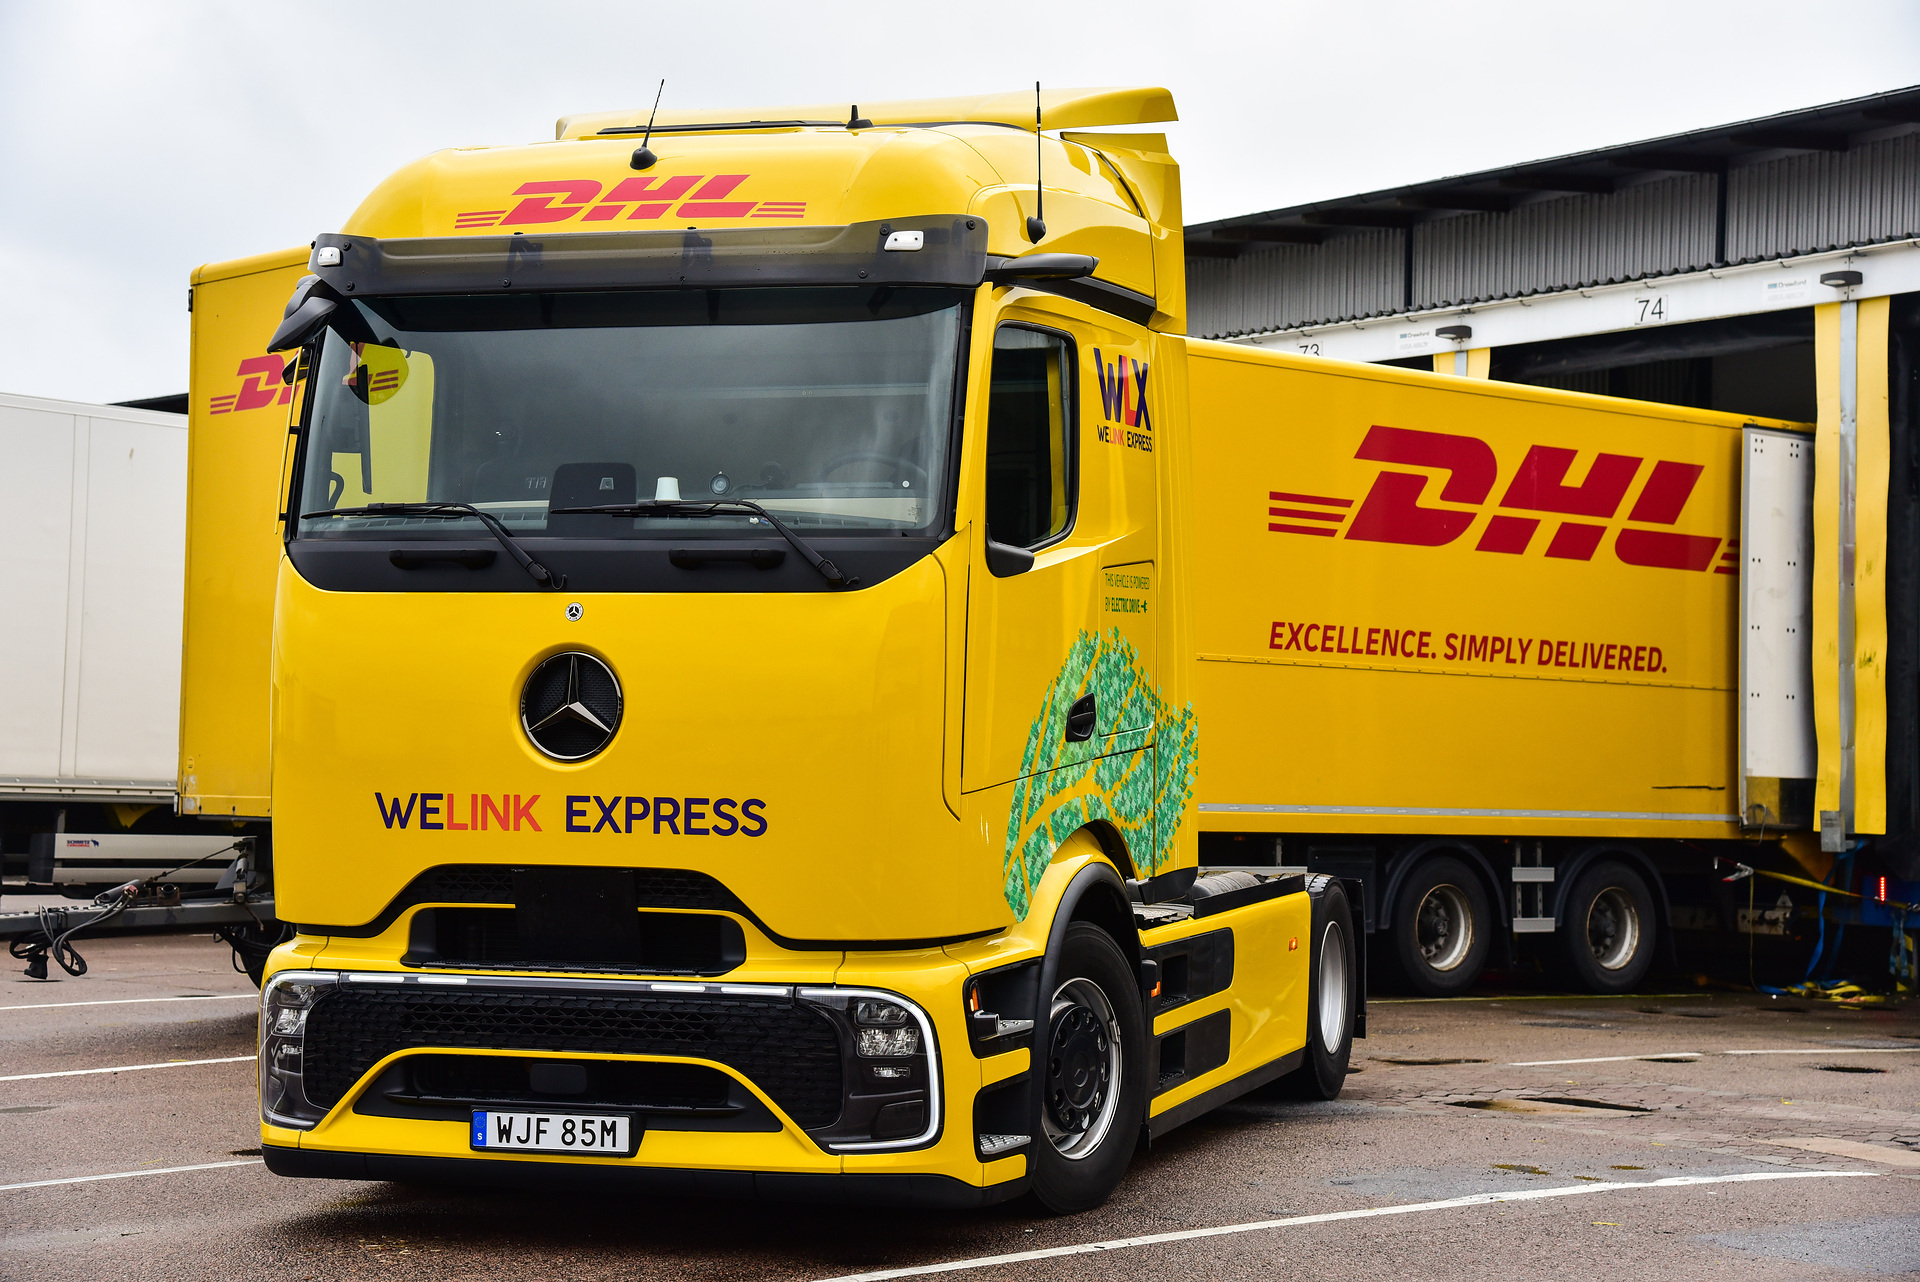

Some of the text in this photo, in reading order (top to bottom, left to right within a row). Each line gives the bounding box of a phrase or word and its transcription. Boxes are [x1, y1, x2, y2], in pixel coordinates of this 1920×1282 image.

[498, 174, 759, 226] DHL
[1638, 297, 1664, 322] 74
[1093, 347, 1152, 431] WLX
[1097, 424, 1153, 453] WELINK EXPRESS
[1344, 424, 1722, 572] DHL
[1105, 572, 1114, 587] THIS
[1114, 573, 1129, 588] VEHICLE
[1133, 575, 1151, 590] POWERED
[1105, 596, 1141, 614] BY ELECTRIC DRIVE
[1269, 621, 1668, 674] EXCELLENCE. SIMPLY DELIVERED.
[374, 792, 769, 838] WELINK EXPRESS
[477, 1132, 484, 1141] S
[496, 1115, 617, 1148] WJF 85M
